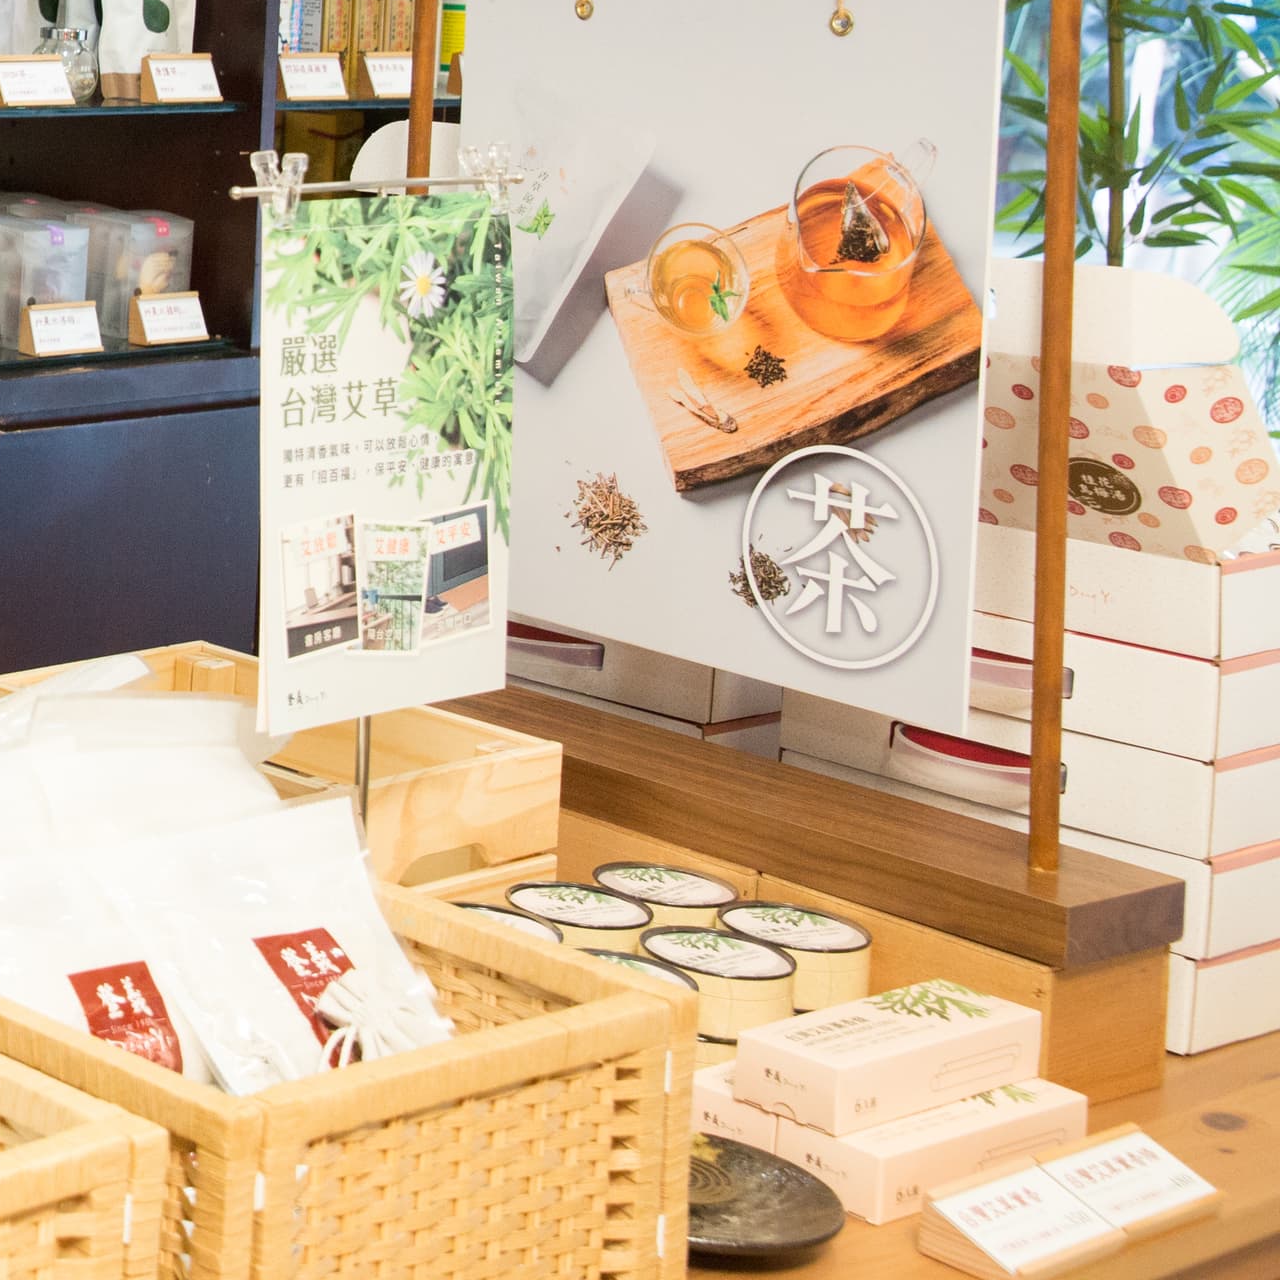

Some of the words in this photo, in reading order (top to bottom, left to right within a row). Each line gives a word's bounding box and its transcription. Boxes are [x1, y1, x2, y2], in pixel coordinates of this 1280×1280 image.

[493, 242, 505, 306] Taiwan
[280, 333, 338, 378] 嚴選
[280, 376, 399, 430] 台灣艾草
[781, 473, 898, 635] 茶
